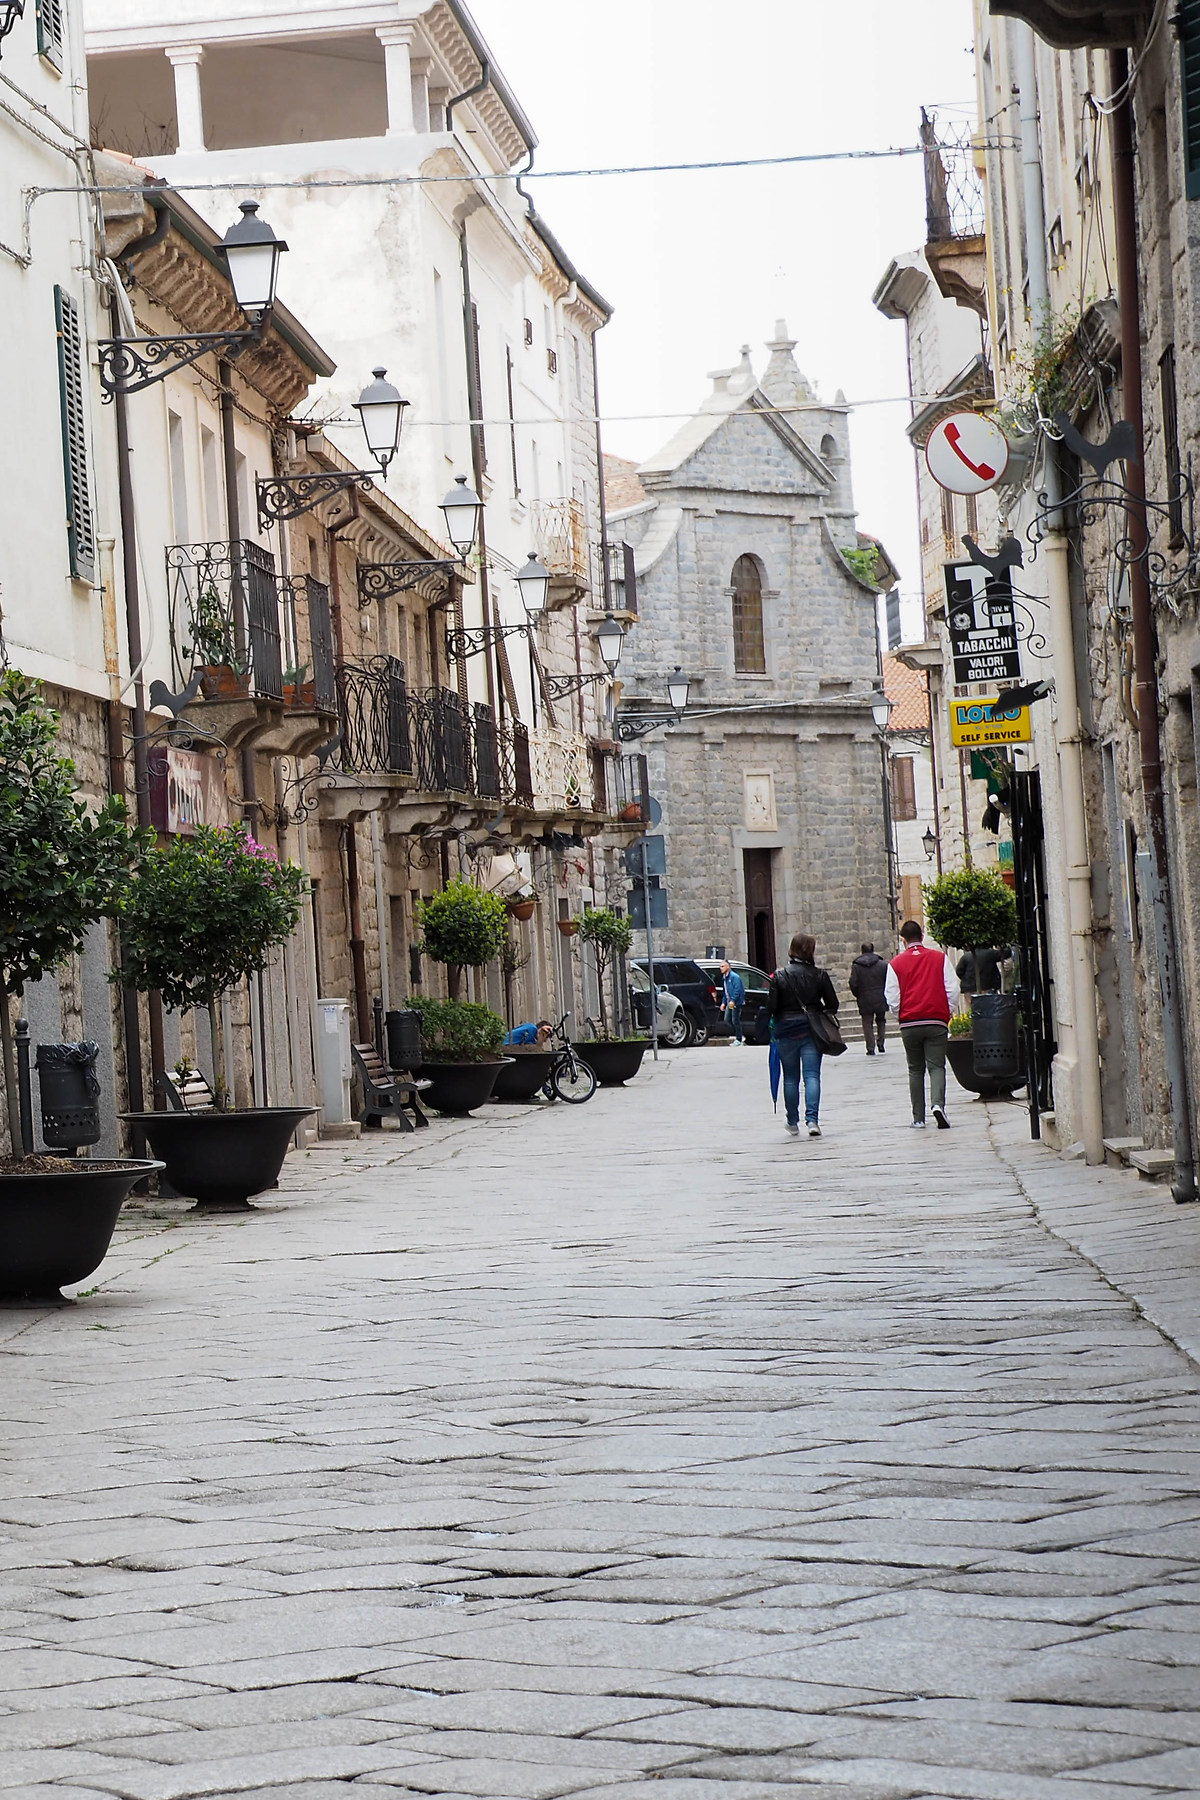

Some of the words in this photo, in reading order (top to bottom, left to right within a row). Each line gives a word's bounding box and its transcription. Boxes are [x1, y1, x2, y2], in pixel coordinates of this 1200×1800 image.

[956, 636, 1013, 654] TABACCHI
[968, 655, 1004, 669] VALORI
[968, 666, 1008, 680] BOLLATI
[960, 733, 981, 743] SELF
[984, 730, 1022, 741] SERVICE
